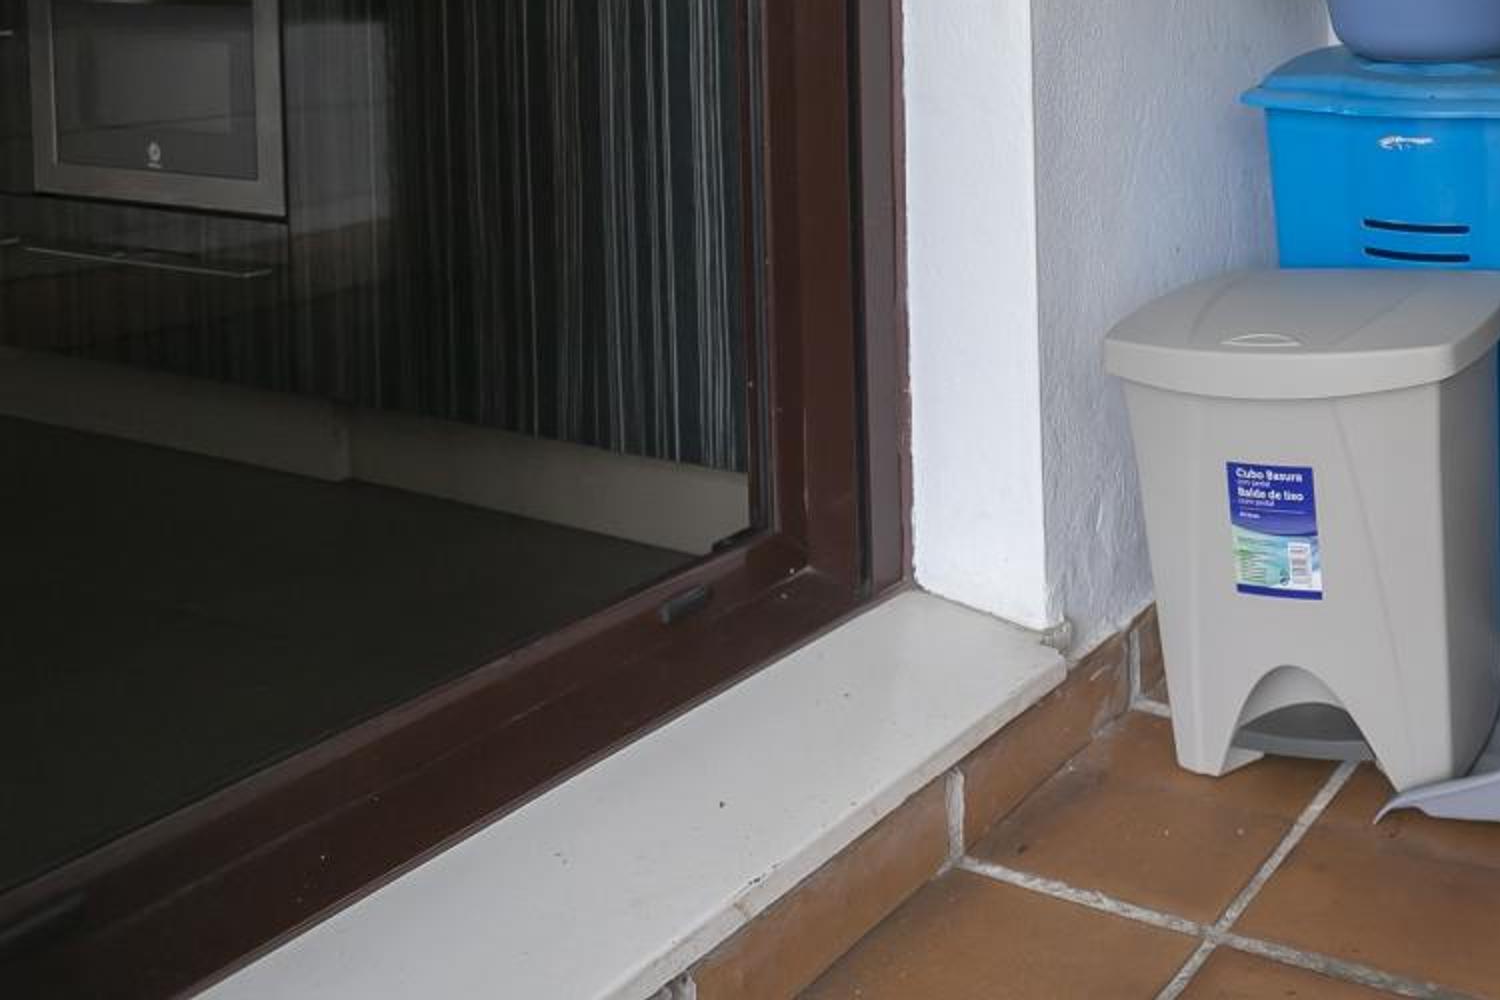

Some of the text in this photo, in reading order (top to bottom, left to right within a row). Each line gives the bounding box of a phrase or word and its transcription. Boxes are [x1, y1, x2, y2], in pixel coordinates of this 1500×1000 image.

[1235, 467, 1303, 483] Cubo Basura
[1238, 487, 1267, 499] Balde
[1267, 489, 1282, 501] de
